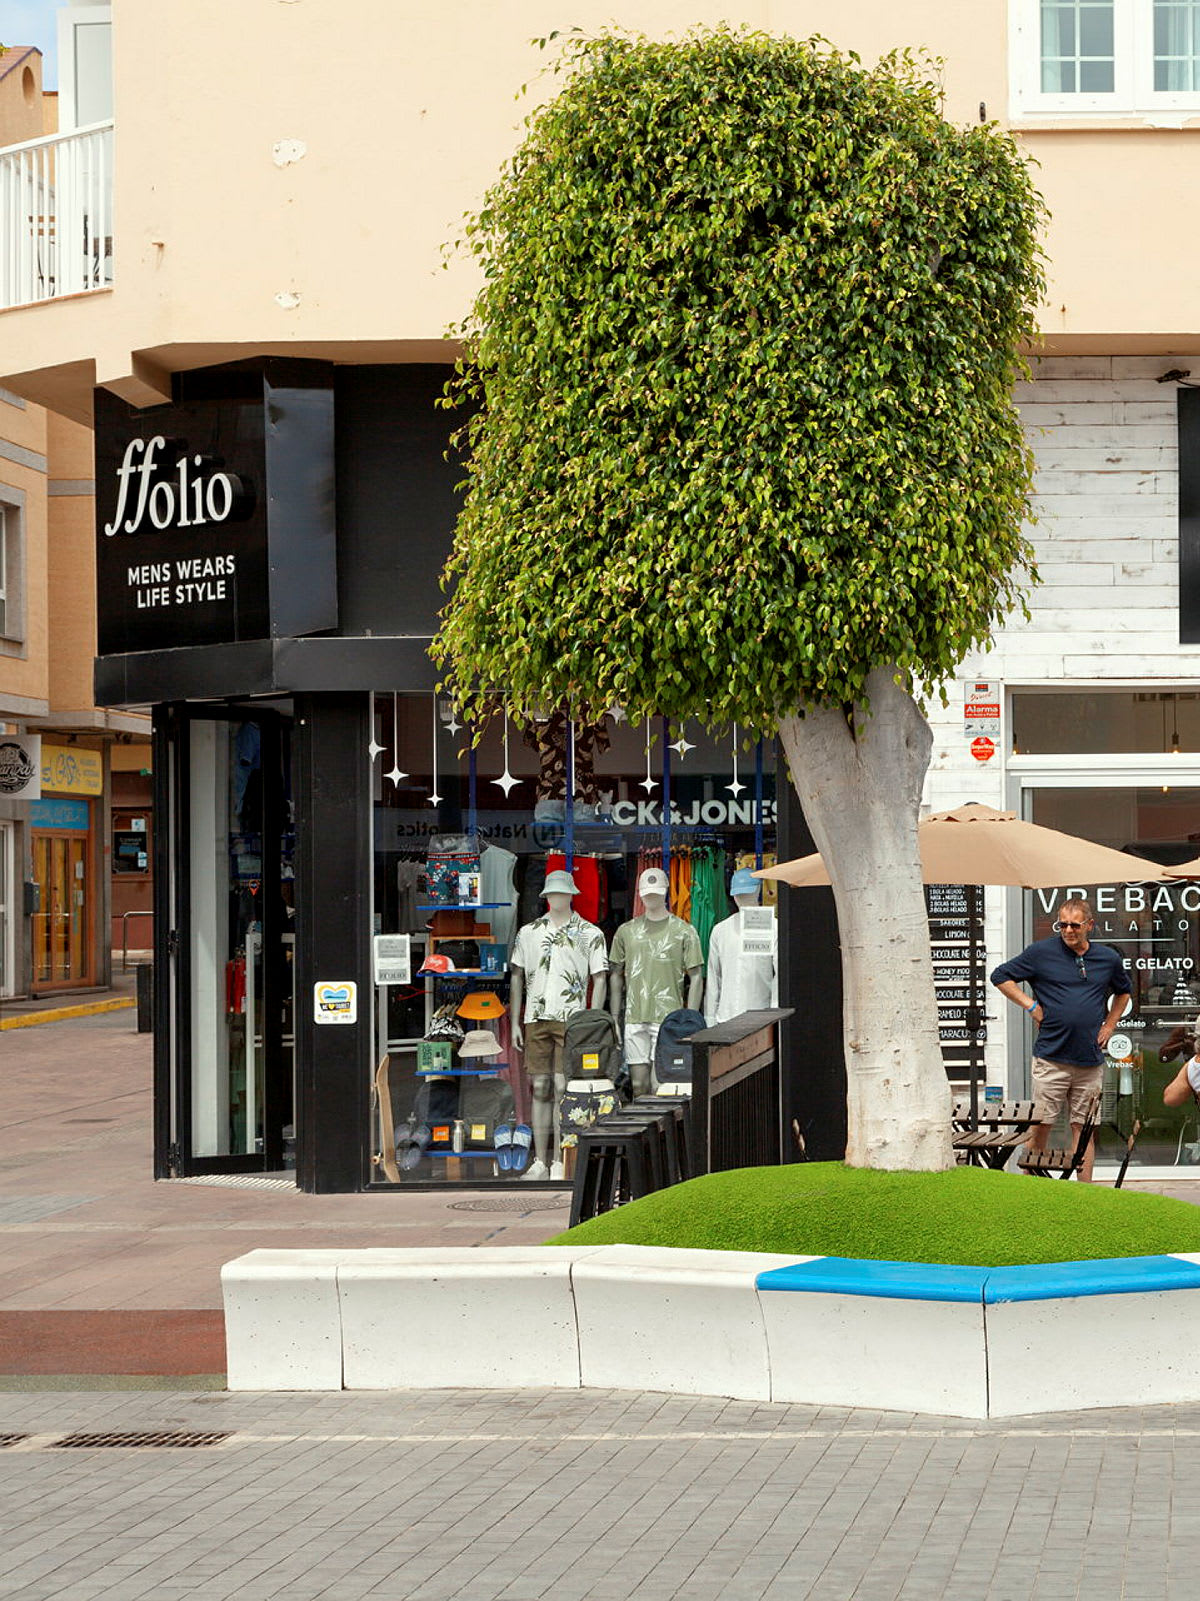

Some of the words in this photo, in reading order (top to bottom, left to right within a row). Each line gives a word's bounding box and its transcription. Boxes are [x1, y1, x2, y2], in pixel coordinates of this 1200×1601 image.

[104, 435, 233, 537] ffolio
[127, 562, 171, 586] MENS
[176, 554, 236, 580] WEARS
[137, 586, 170, 609] LIFE
[175, 579, 226, 604] STYLE
[611, 800, 778, 826] CK&JONE
[1052, 920, 1189, 933] GLATO
[961, 949, 980, 959] NEO
[1135, 957, 1194, 970] GELATO
[935, 990, 964, 999] HOCOLATE
[938, 1008, 961, 1019] RAMELO
[1106, 1060, 1134, 1069] Vrebac
